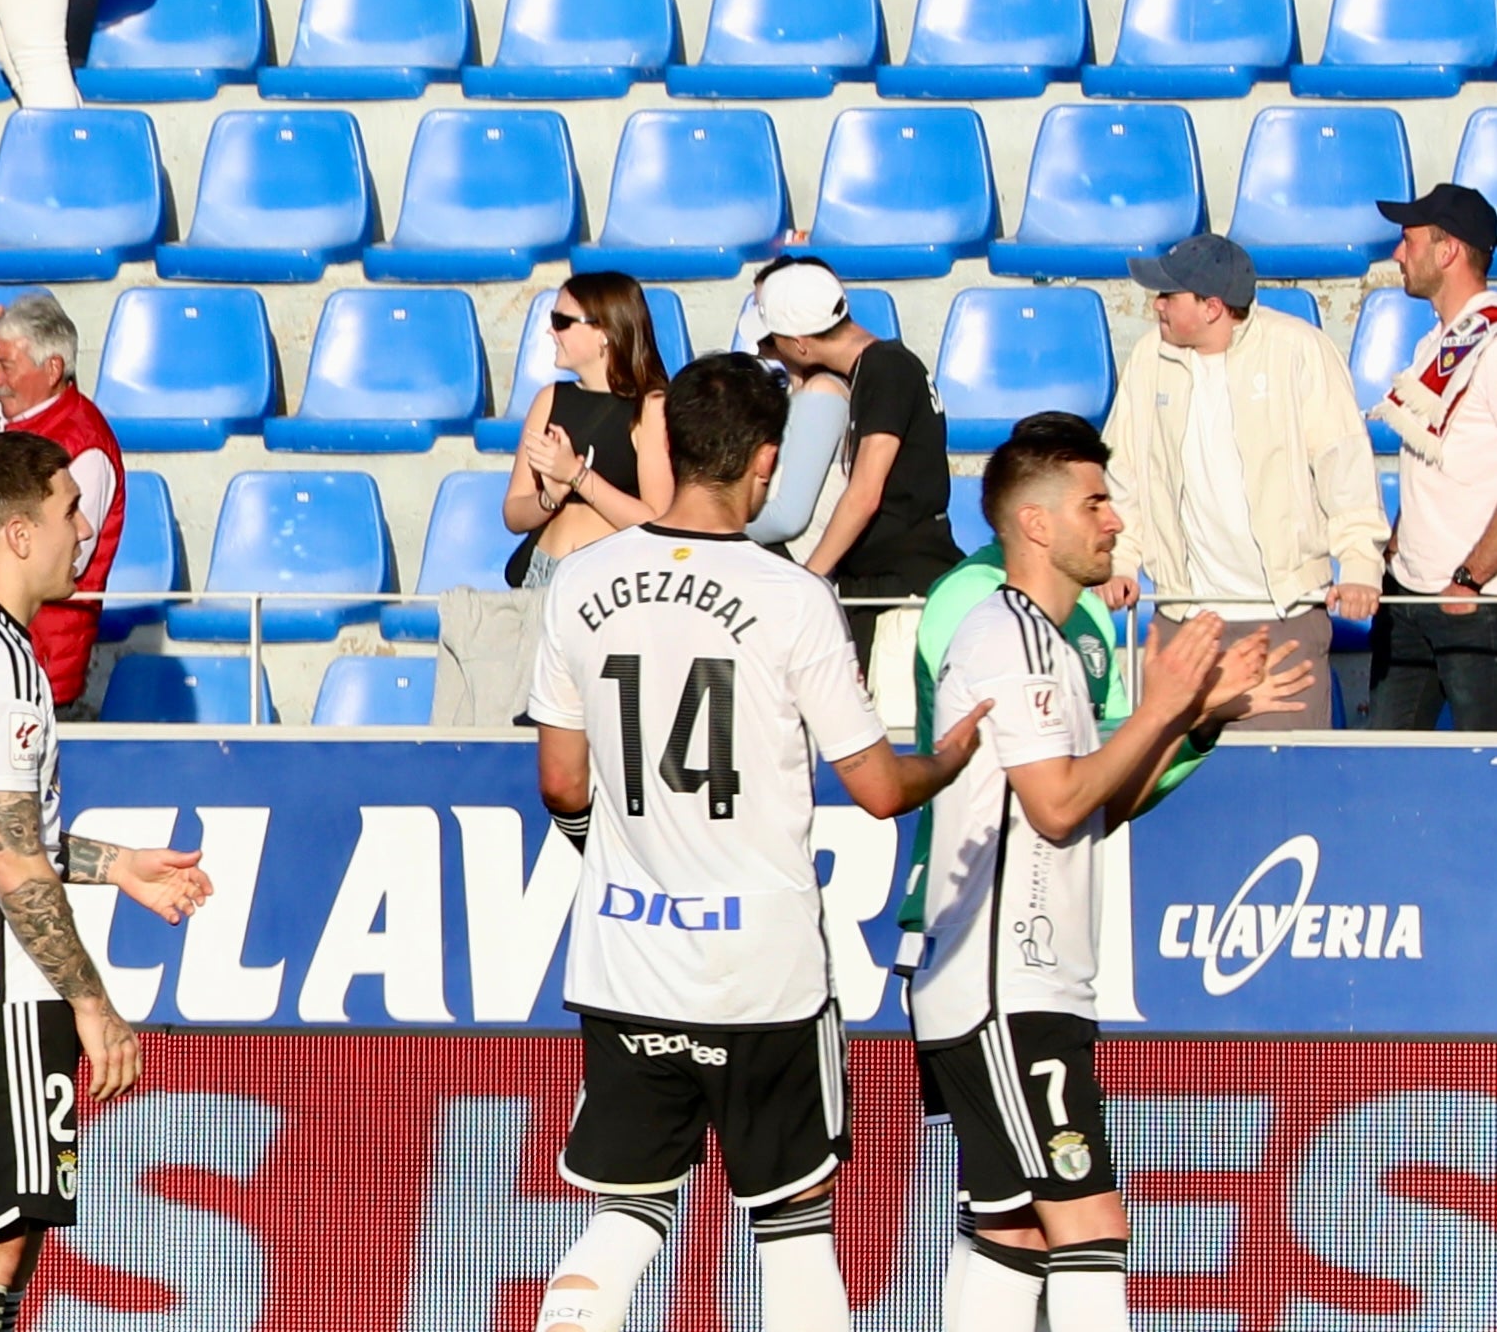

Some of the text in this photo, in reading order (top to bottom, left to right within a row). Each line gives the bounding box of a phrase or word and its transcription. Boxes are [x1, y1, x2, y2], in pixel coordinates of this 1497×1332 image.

[577, 571, 758, 646] ELGEZABAL
[600, 654, 741, 821] 14
[597, 883, 741, 932] DIGI
[1159, 904, 1423, 959] CLAVERIA
[1029, 1058, 1070, 1128] 7
